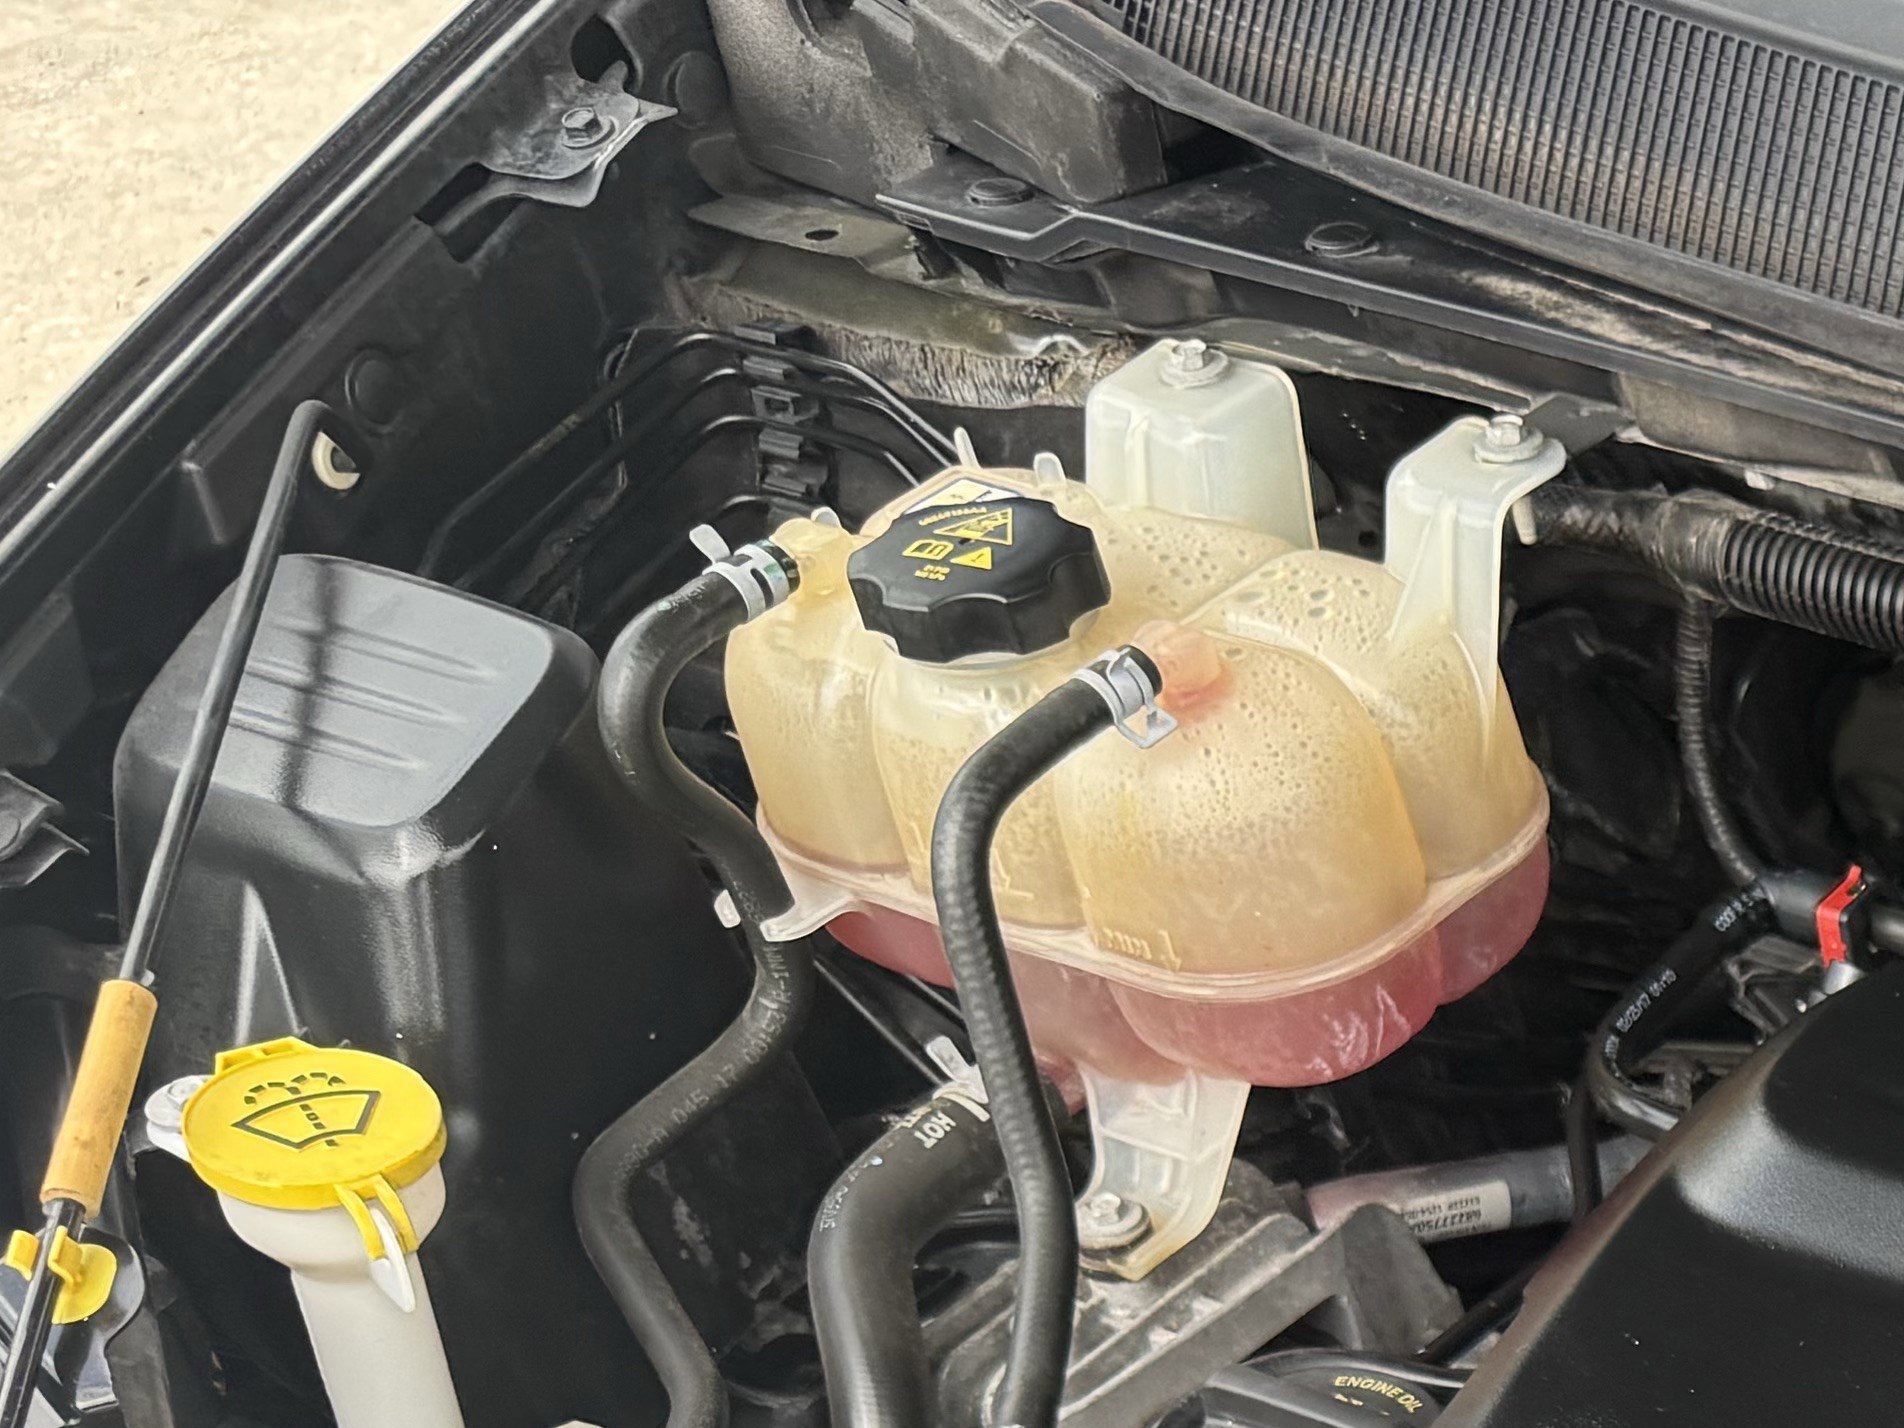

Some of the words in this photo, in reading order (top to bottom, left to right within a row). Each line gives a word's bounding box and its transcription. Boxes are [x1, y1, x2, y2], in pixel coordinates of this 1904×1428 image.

[914, 1110, 957, 1149] HOT
[1334, 1375, 1402, 1400] ENGINE
[1399, 1394, 1424, 1415] OIL
